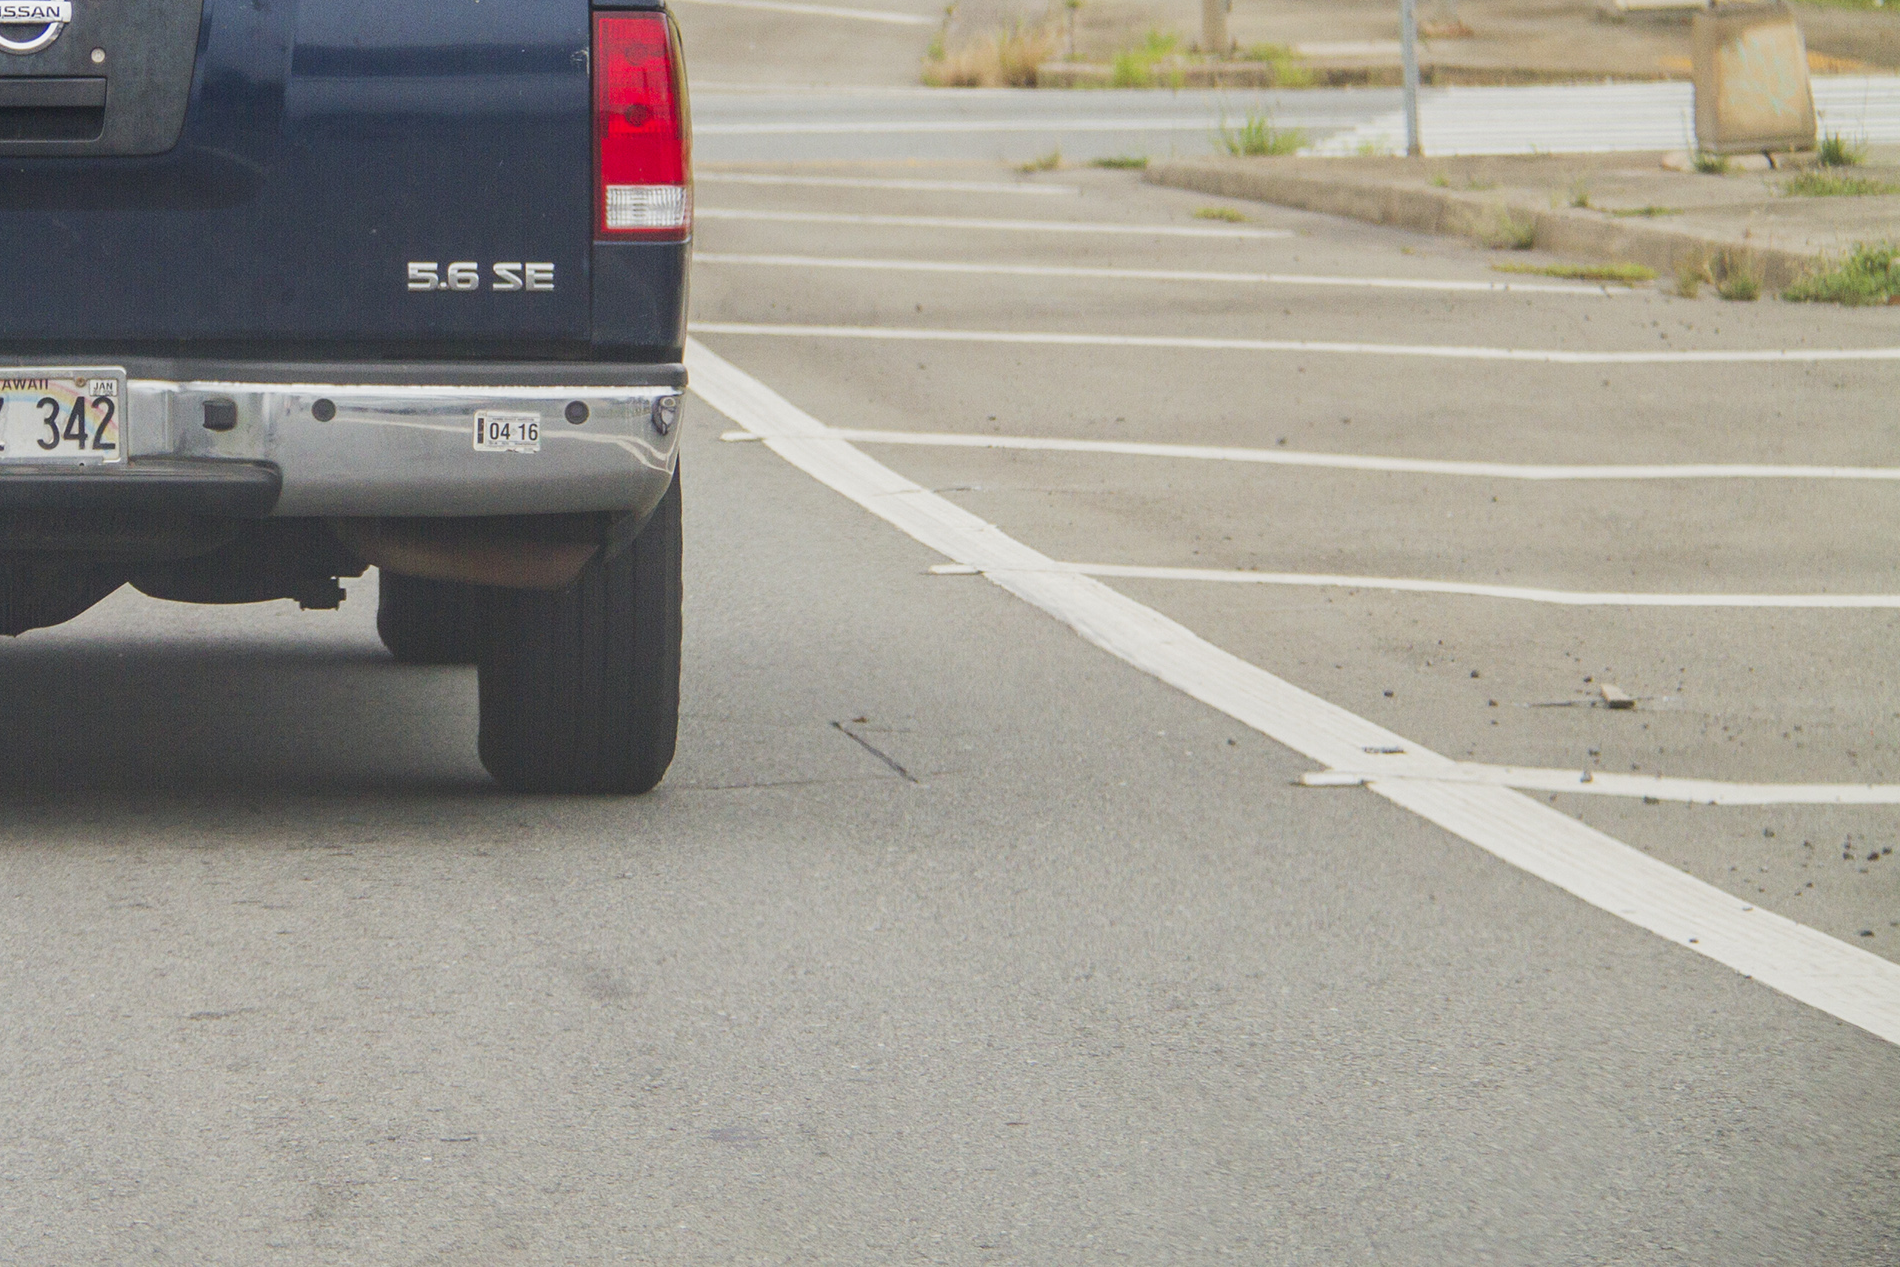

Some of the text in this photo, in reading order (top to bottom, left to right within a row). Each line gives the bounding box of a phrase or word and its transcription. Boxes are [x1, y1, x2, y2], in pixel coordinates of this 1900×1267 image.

[407, 262, 555, 291] 5.6 SE
[93, 382, 114, 391] JAN
[36, 396, 116, 450] 342
[489, 422, 538, 441] 04 16
